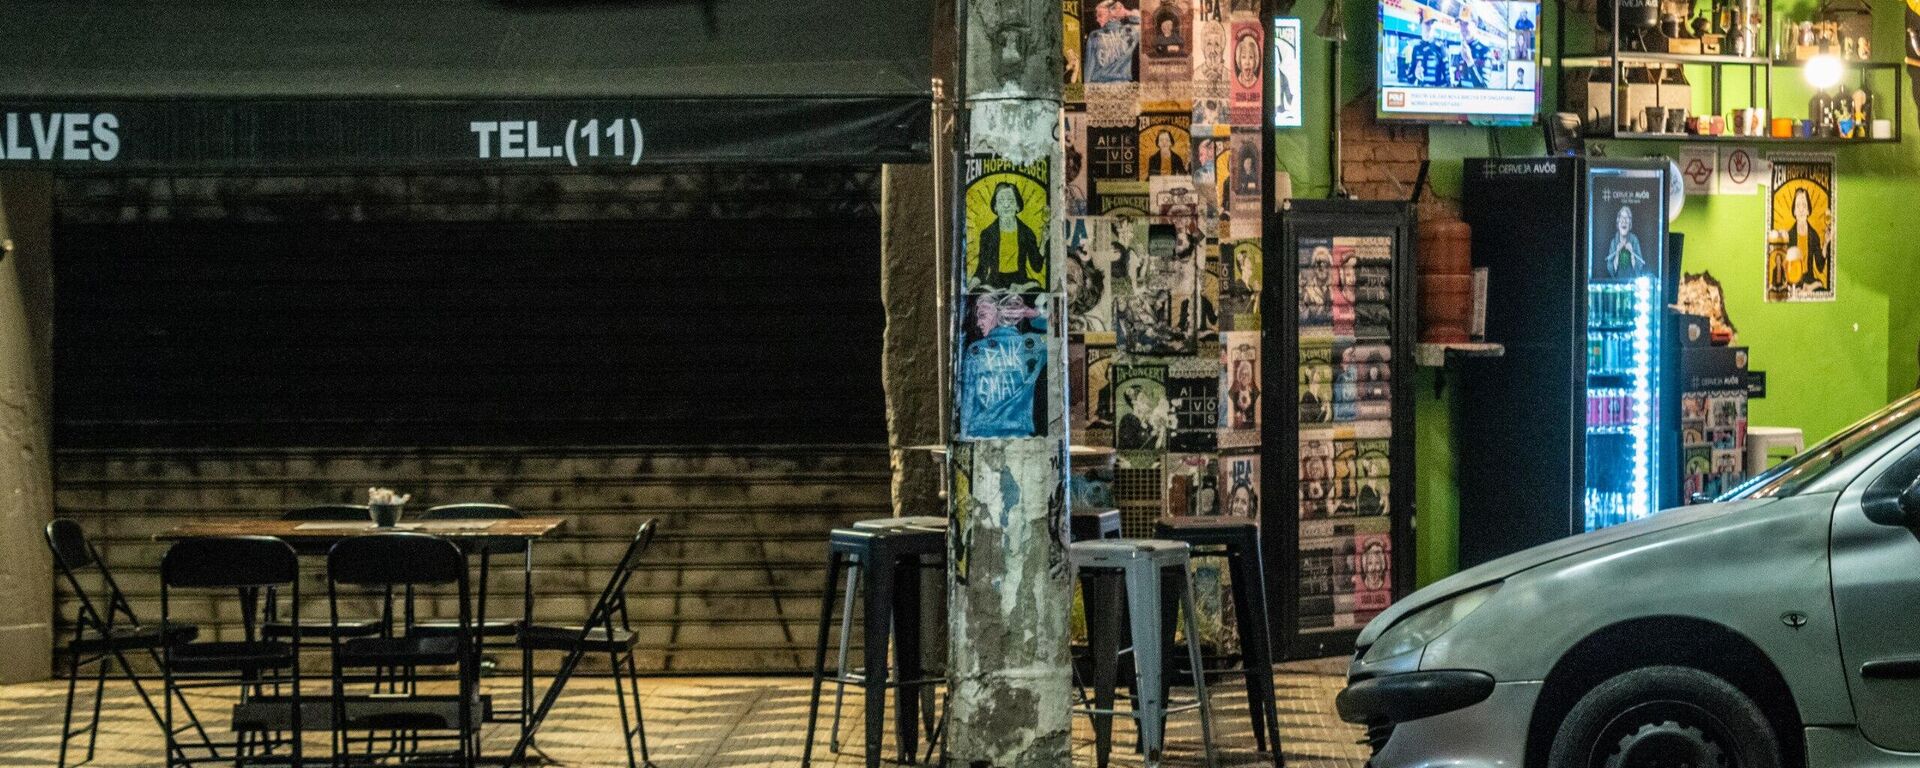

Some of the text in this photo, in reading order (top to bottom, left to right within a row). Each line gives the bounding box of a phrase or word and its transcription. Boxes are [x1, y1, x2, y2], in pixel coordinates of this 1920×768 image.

[0, 113, 119, 161] LVES
[470, 118, 643, 166] TEL.(11)
[966, 159, 982, 185] ZEN
[1533, 161, 1556, 173] AVÓS
[1774, 164, 1786, 190] ZEN
